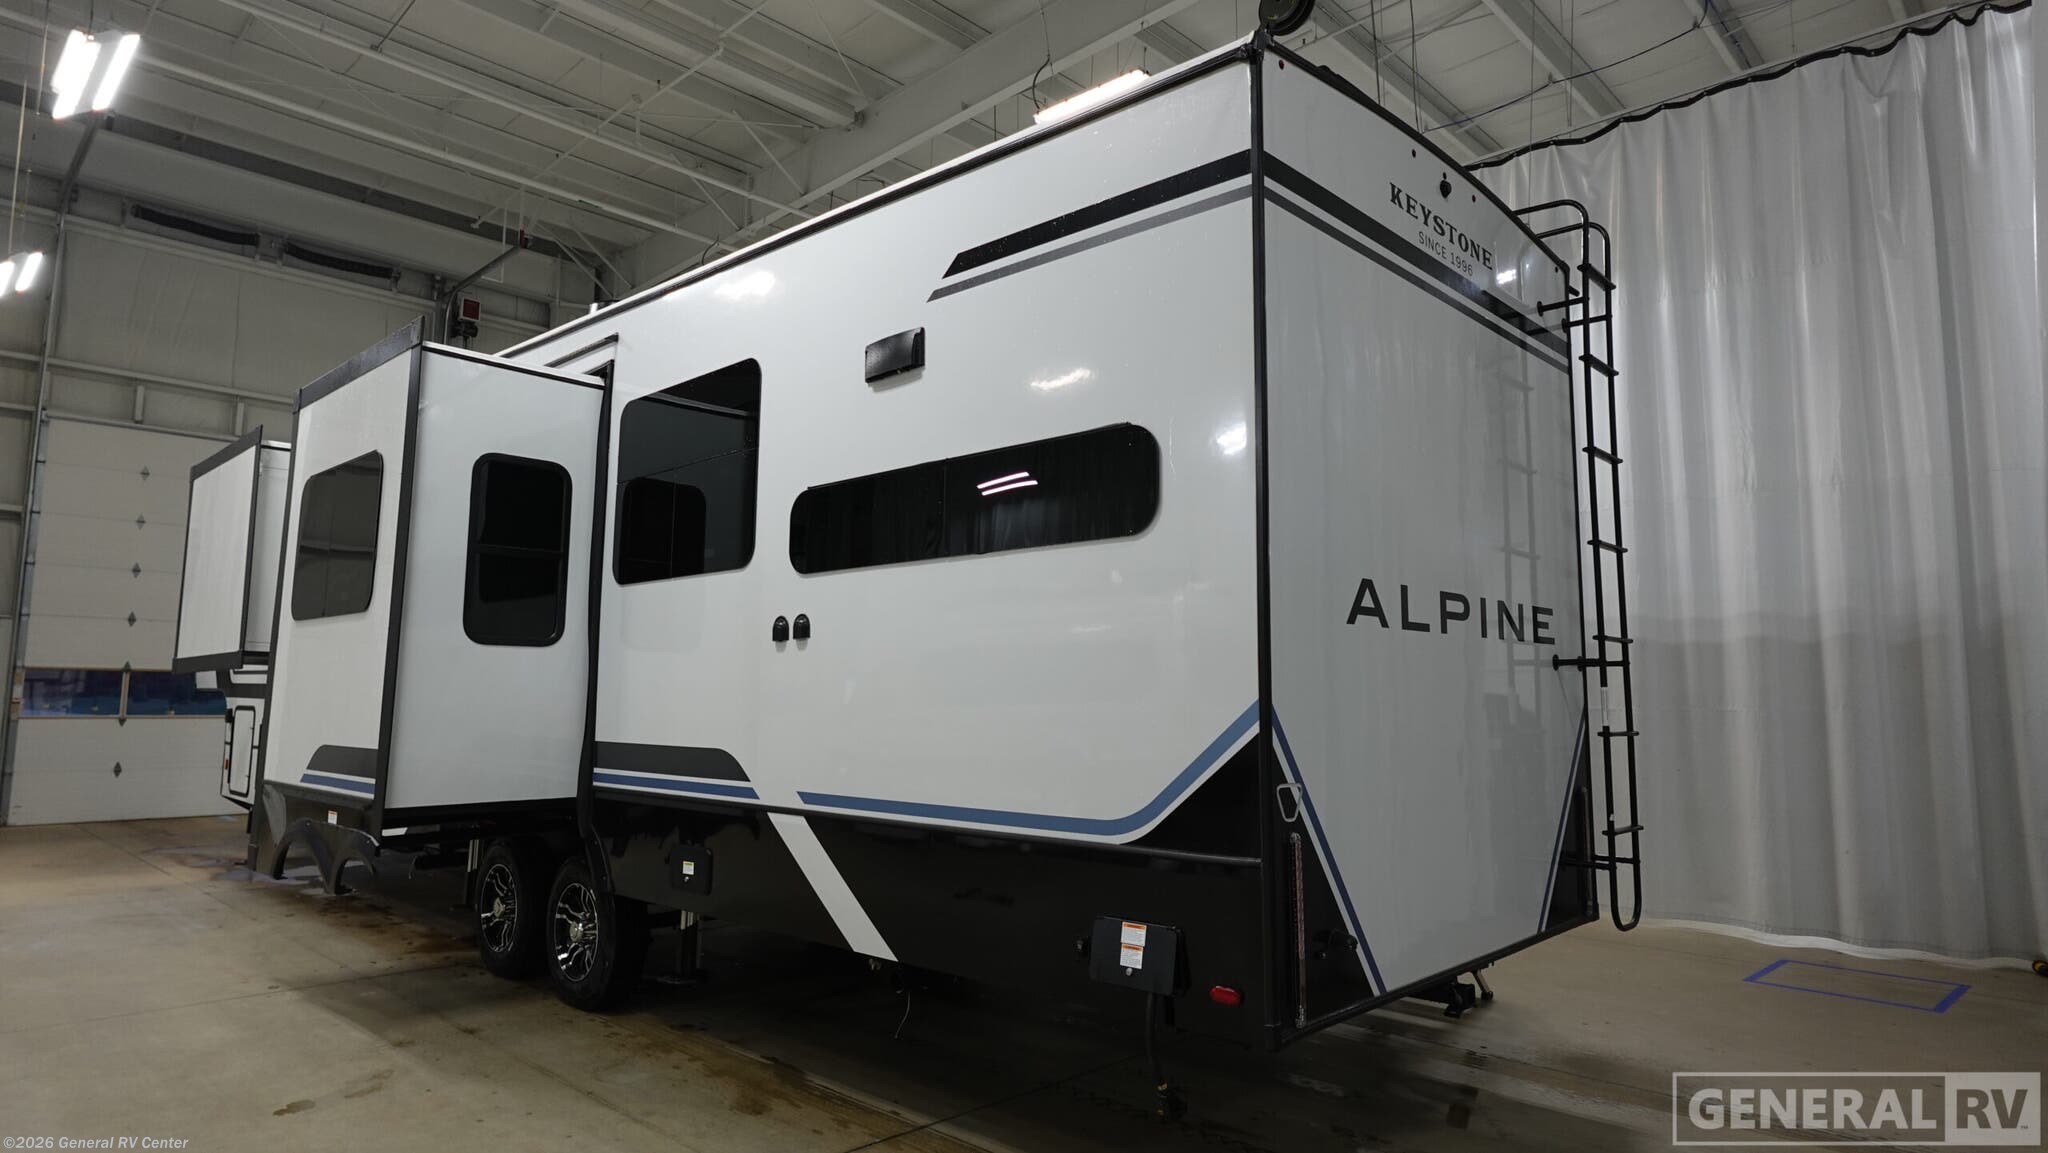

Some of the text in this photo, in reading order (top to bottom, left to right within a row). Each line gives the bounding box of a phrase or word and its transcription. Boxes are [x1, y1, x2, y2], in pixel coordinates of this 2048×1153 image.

[1389, 182, 1493, 270] KEYSTONE
[1418, 231, 1474, 277] SINCE 1996
[1346, 578, 1556, 645] ALPINE
